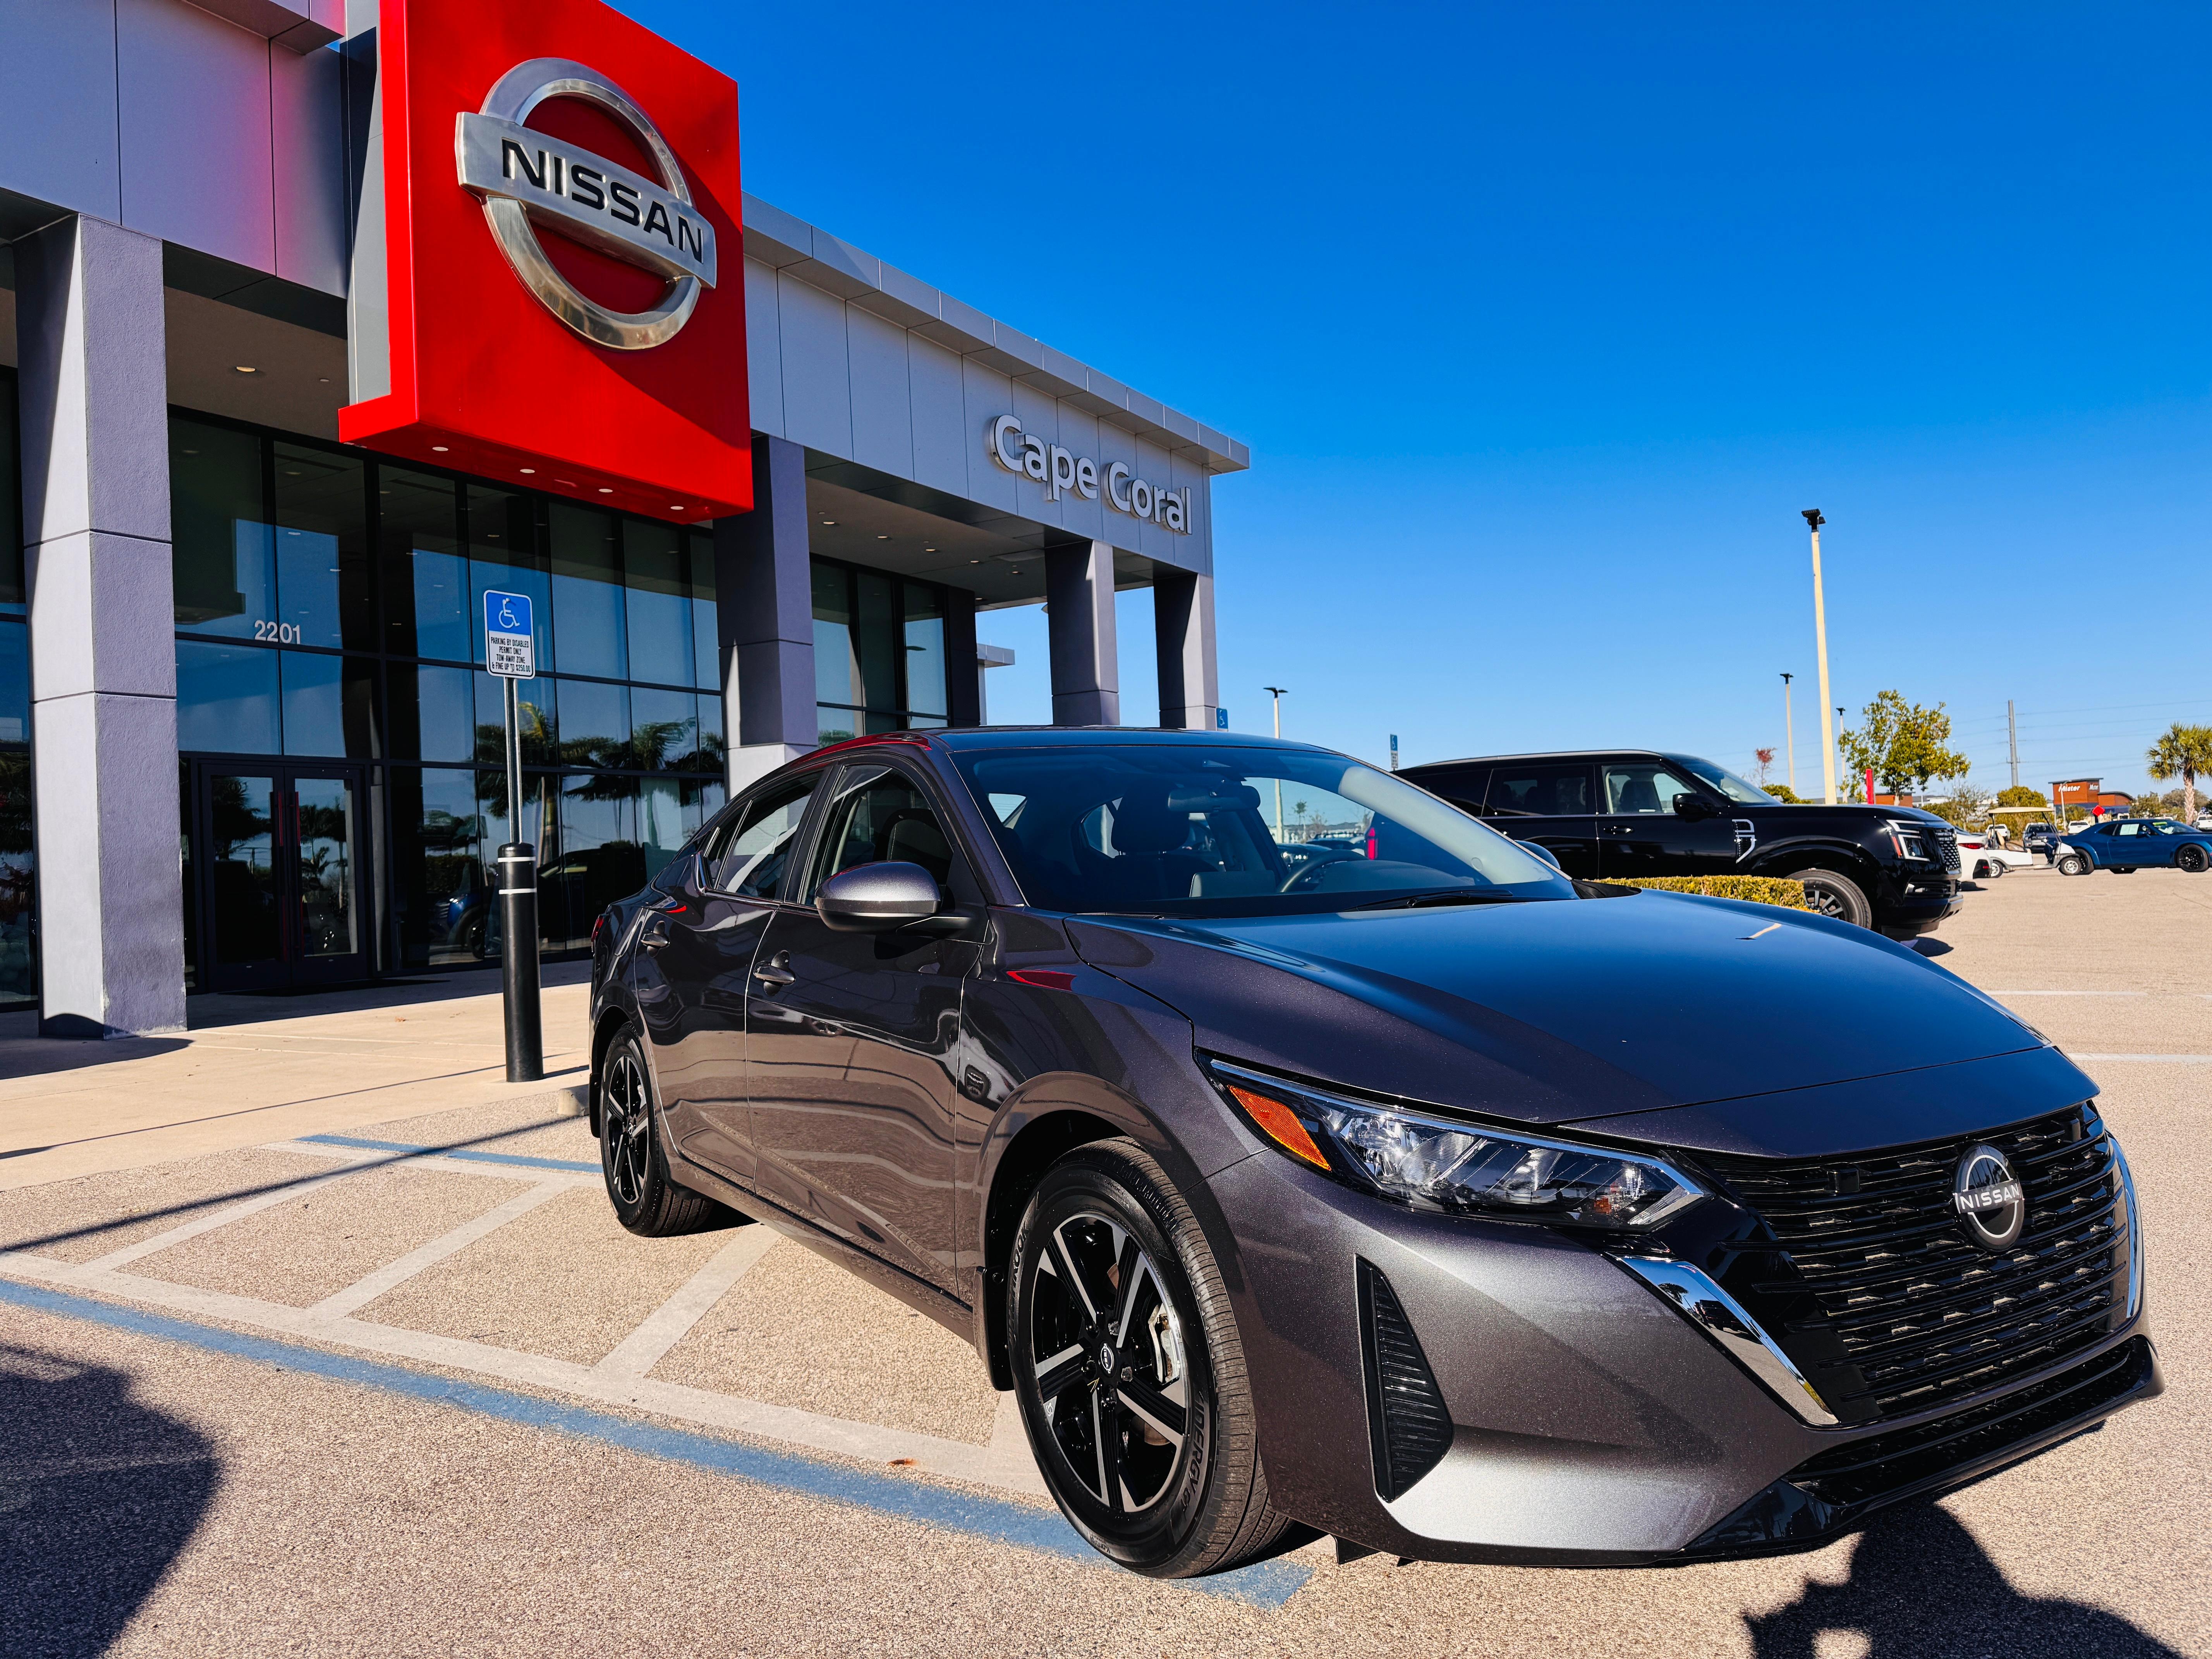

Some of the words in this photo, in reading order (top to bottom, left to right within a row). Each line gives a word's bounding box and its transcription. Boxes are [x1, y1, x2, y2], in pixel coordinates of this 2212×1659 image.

[501, 137, 704, 264] NISSAN
[989, 414, 1098, 502] Cape
[1104, 461, 1192, 535] Coral
[254, 620, 301, 645] 2201
[491, 637, 506, 645] PARKING
[512, 639, 529, 648] DISABLED
[496, 654, 515, 663] TOW-AWAY
[510, 664, 515, 672] TO
[516, 664, 531, 672] $250.00
[2058, 784, 2080, 792] Mister
[1960, 1183, 2020, 1210] NISSAN
